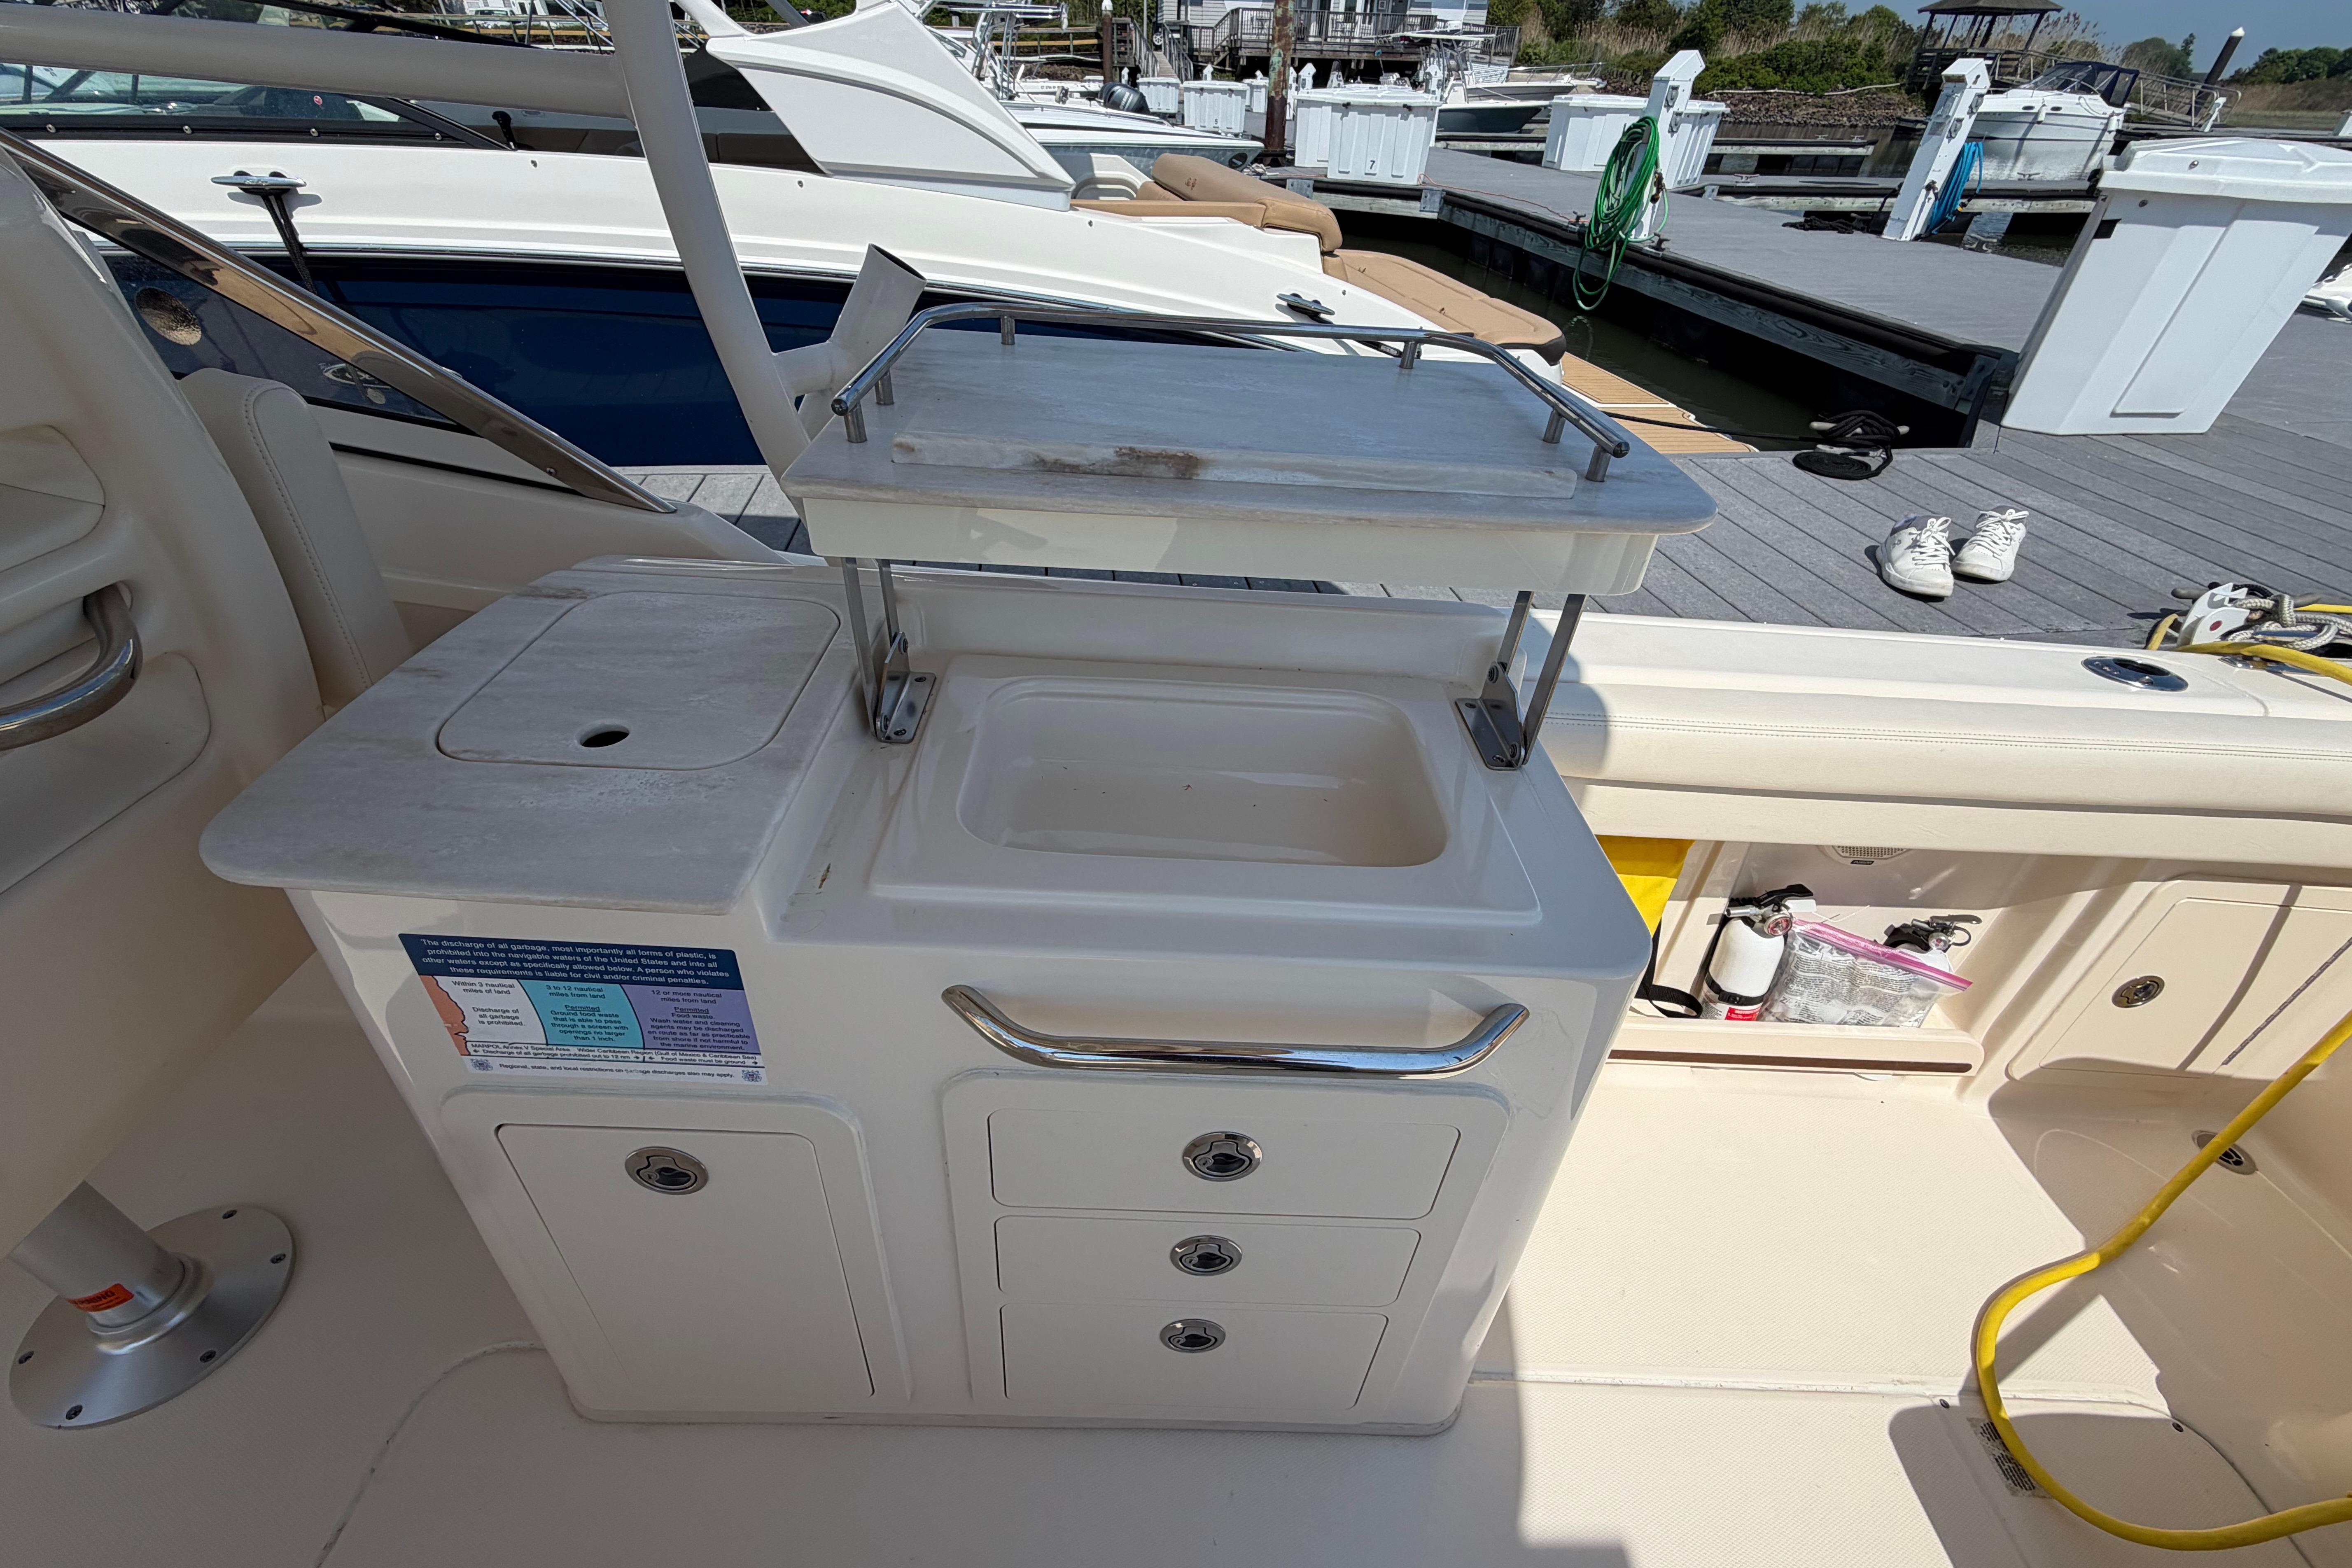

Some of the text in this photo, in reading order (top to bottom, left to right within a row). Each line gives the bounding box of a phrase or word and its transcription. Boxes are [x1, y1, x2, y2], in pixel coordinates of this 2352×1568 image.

[1370, 160, 1376, 170] 7
[441, 940, 484, 949] discharge
[576, 947, 623, 955] importantly
